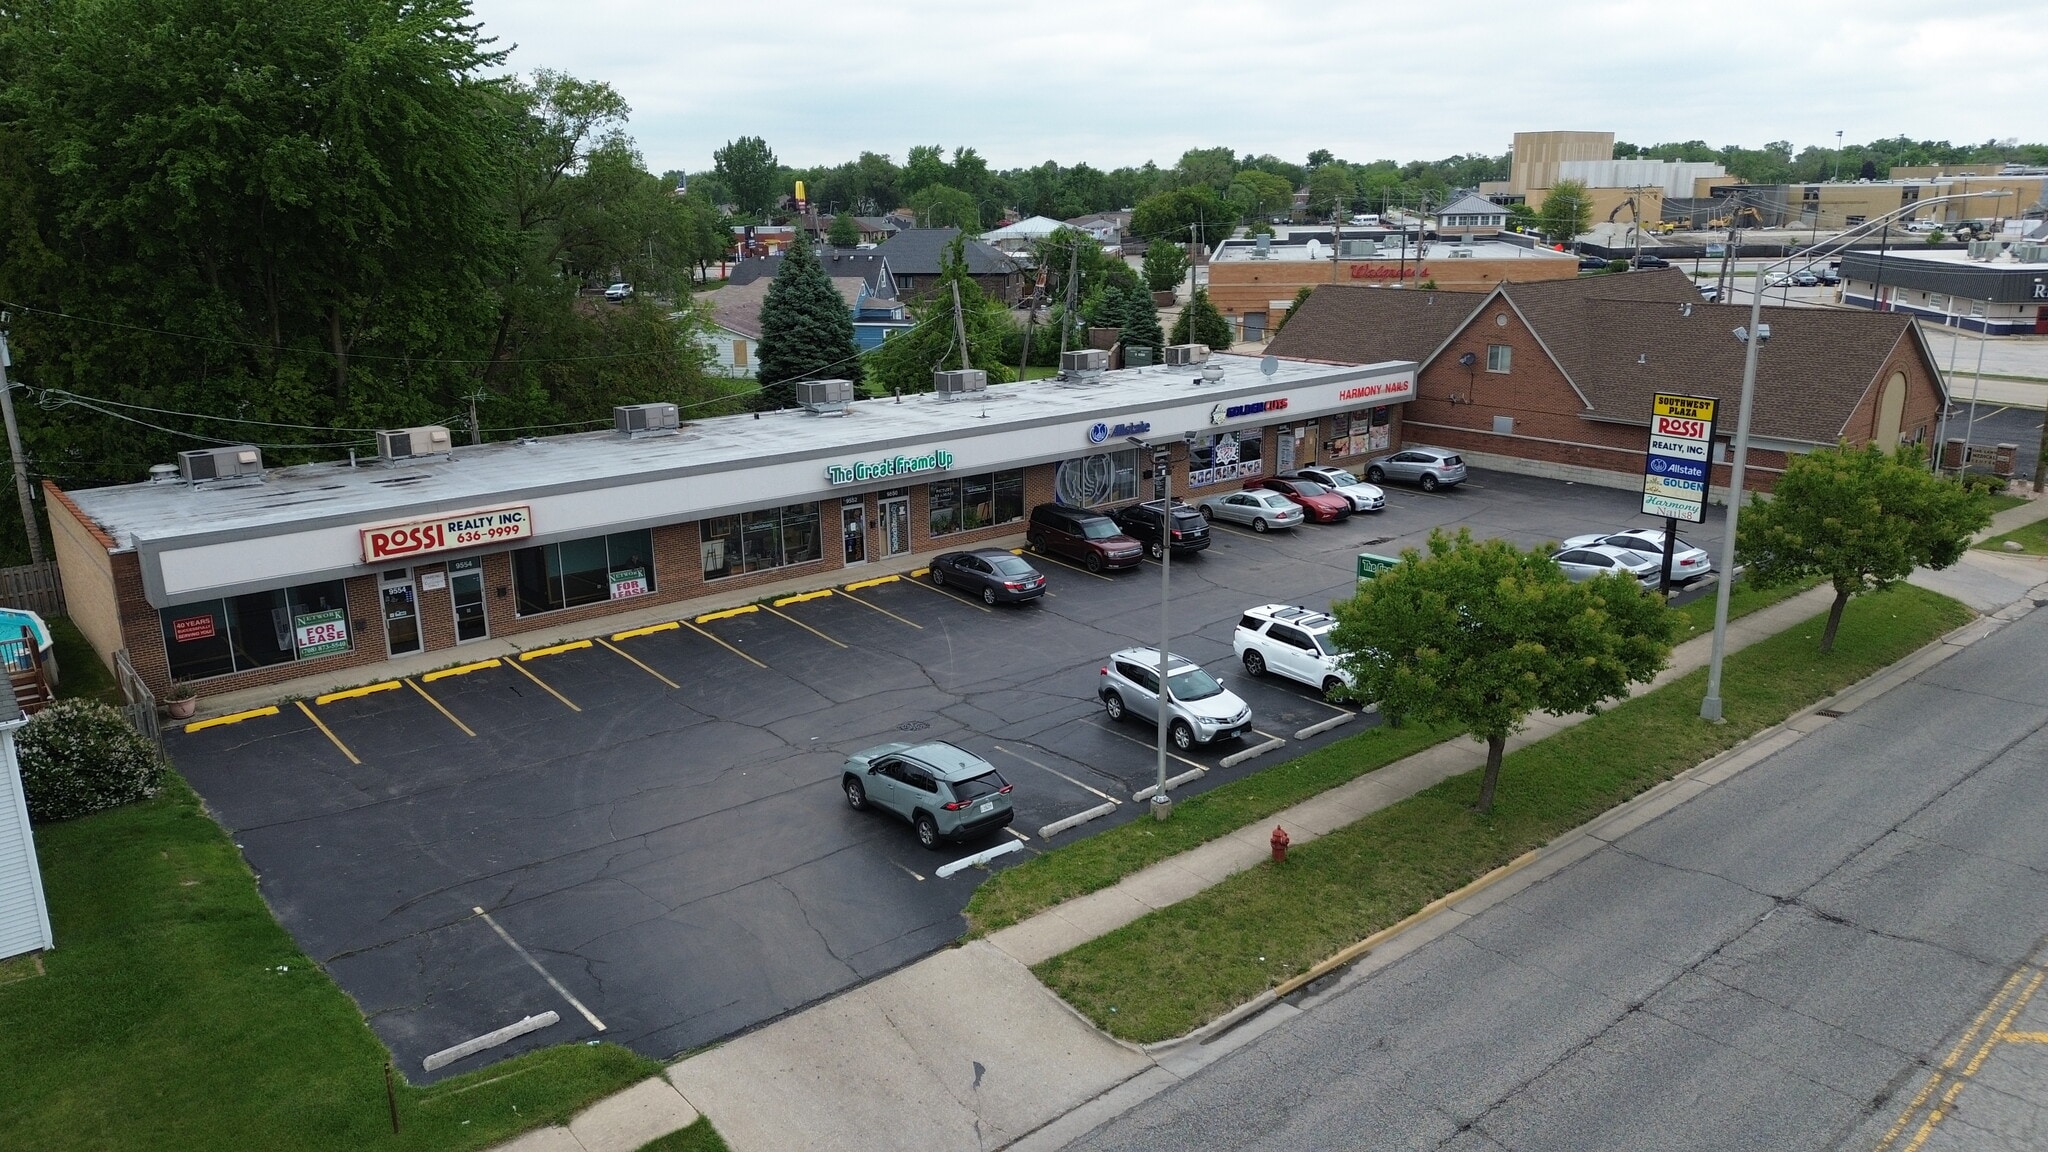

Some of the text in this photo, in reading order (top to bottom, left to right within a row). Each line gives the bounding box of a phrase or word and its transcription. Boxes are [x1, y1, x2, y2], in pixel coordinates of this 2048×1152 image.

[1340, 381, 1409, 400] HARMONY NAILS
[1658, 397, 1711, 410] SOUTHWEST
[1669, 407, 1697, 417] PLAZA
[1658, 417, 1704, 439] ROSSI
[1652, 441, 1706, 456] REALTY, INC.
[829, 449, 954, 485] The Great Frame Up
[1667, 464, 1702, 477] Allstate
[1663, 478, 1705, 492] GOLDEN
[1645, 496, 1700, 514] Harmony
[371, 512, 526, 557] ROSSI REALTY INC.
[457, 525, 520, 543] 636-9999
[455, 561, 473, 569] 9554
[1362, 560, 1377, 573] The
[609, 569, 644, 581] NETWORK
[389, 586, 407, 595] 9554
[612, 587, 646, 599] LEASE
[616, 581, 639, 592] FOR
[185, 618, 211, 627] YEARS
[297, 609, 343, 626] NETWORK
[306, 624, 336, 637] FOR
[298, 630, 345, 646] LEASE
